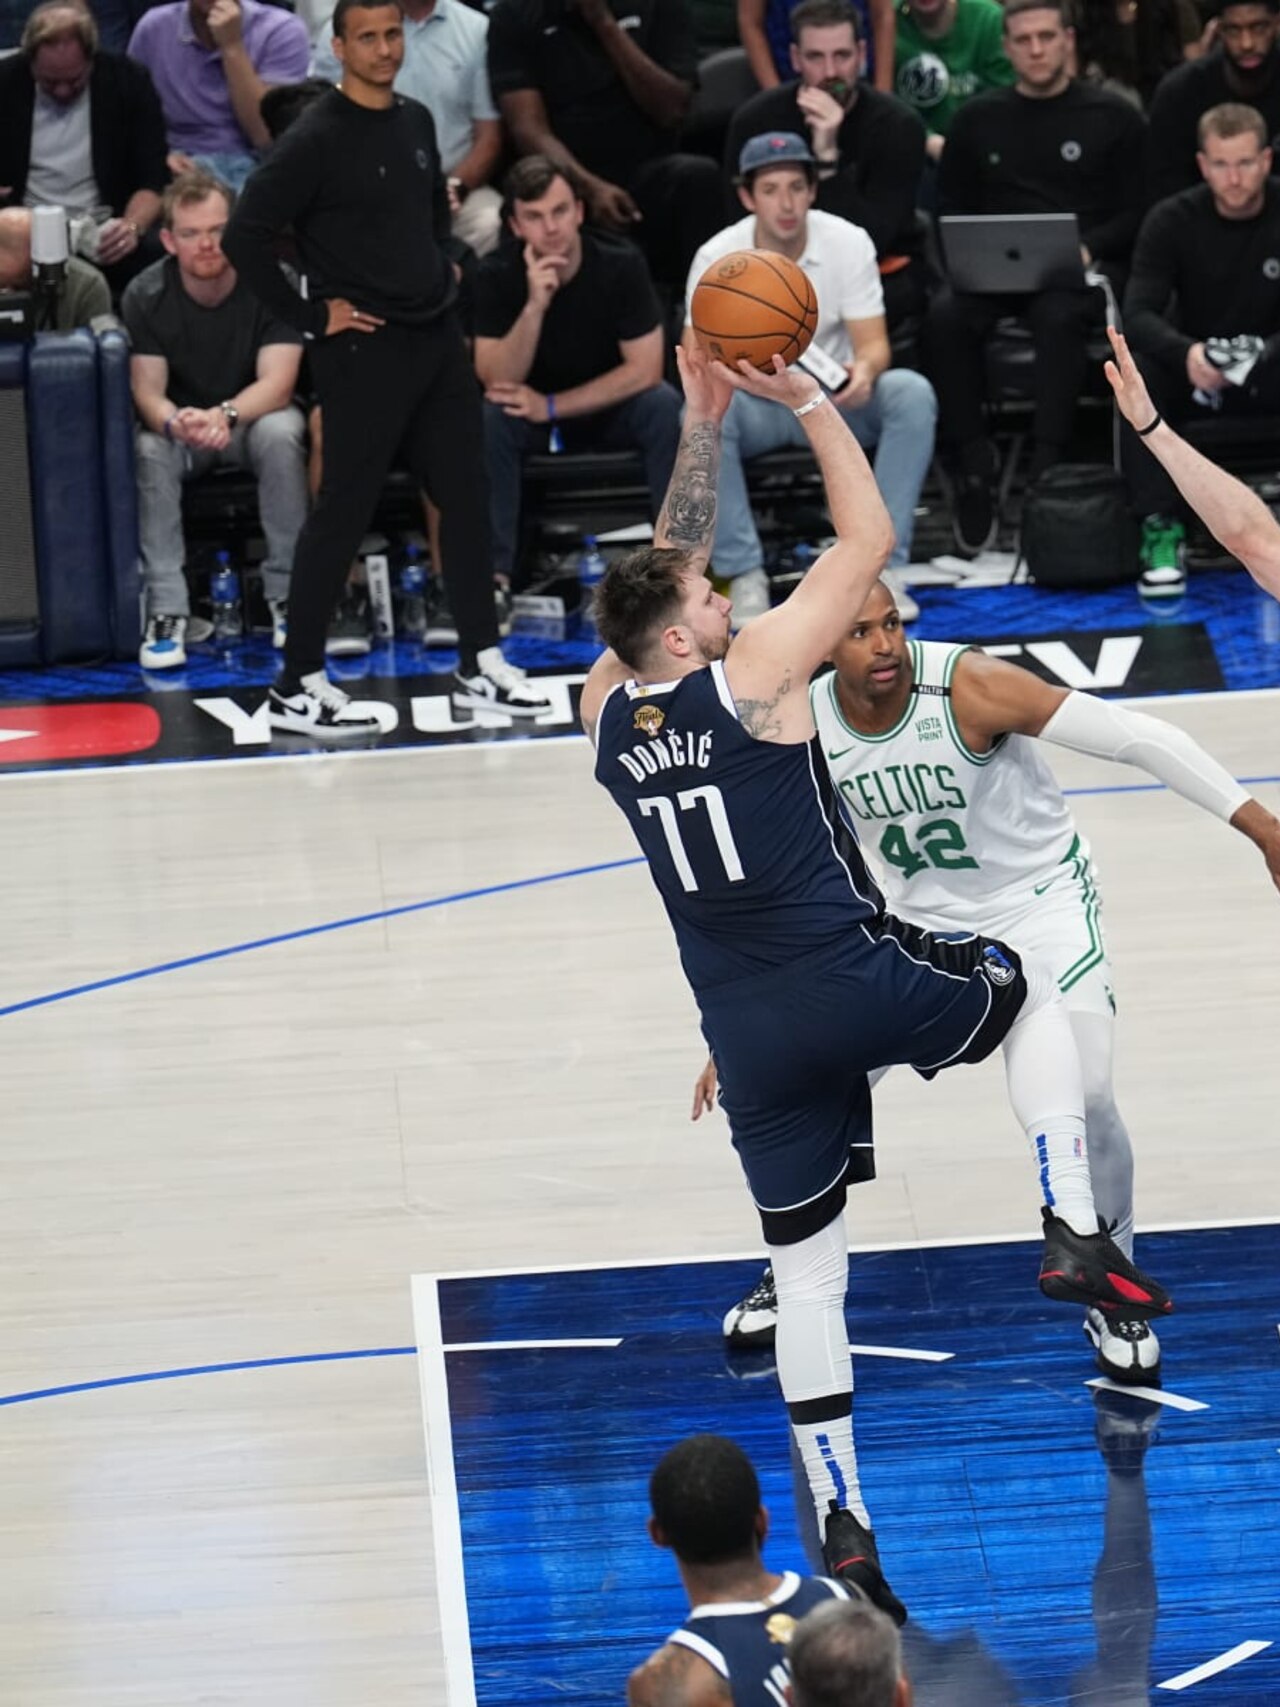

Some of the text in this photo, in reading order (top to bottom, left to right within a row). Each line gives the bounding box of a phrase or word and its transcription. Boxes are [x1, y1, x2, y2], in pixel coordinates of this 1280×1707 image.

[915, 717, 942, 733] VISTA
[918, 730, 943, 743] PRINT
[617, 728, 713, 783] DONČIĆ
[838, 763, 967, 820] CELTICS
[637, 784, 746, 893] 77
[879, 818, 981, 880] 42
